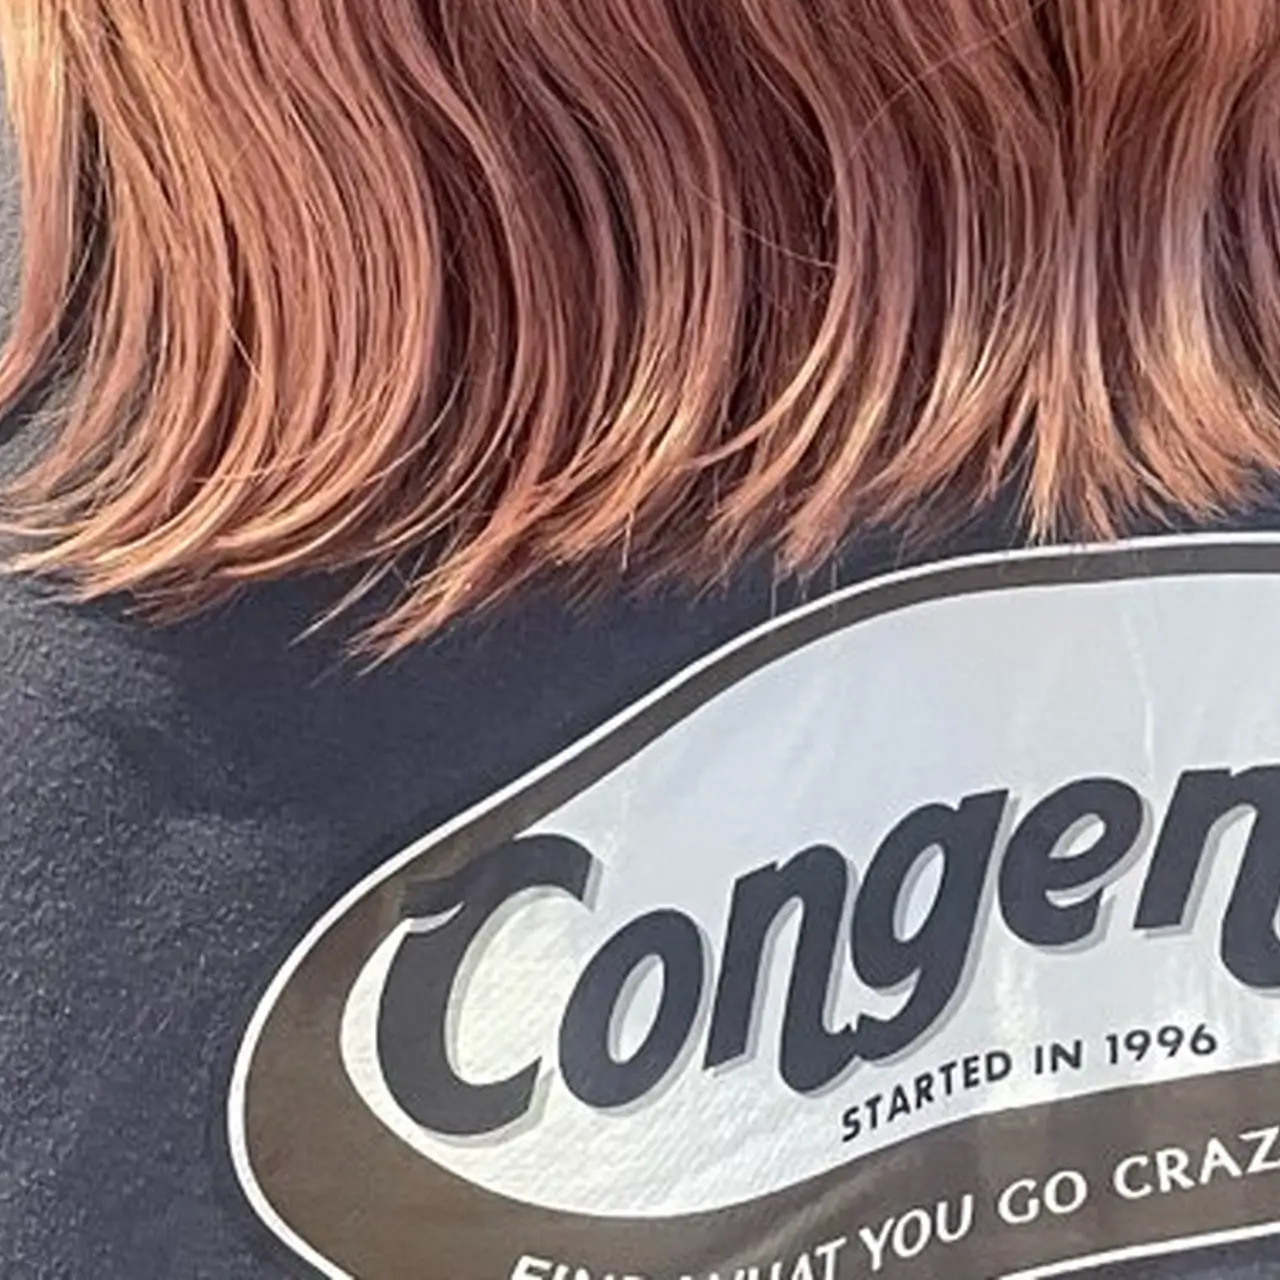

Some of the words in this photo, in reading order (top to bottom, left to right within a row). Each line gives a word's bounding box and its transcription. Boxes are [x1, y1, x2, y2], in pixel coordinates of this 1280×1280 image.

[841, 1049, 1013, 1142] STARTED
[1033, 1039, 1083, 1076] IN
[1105, 1022, 1219, 1065] 1996
[858, 1193, 974, 1272] YOU
[997, 1169, 1088, 1225] GO
